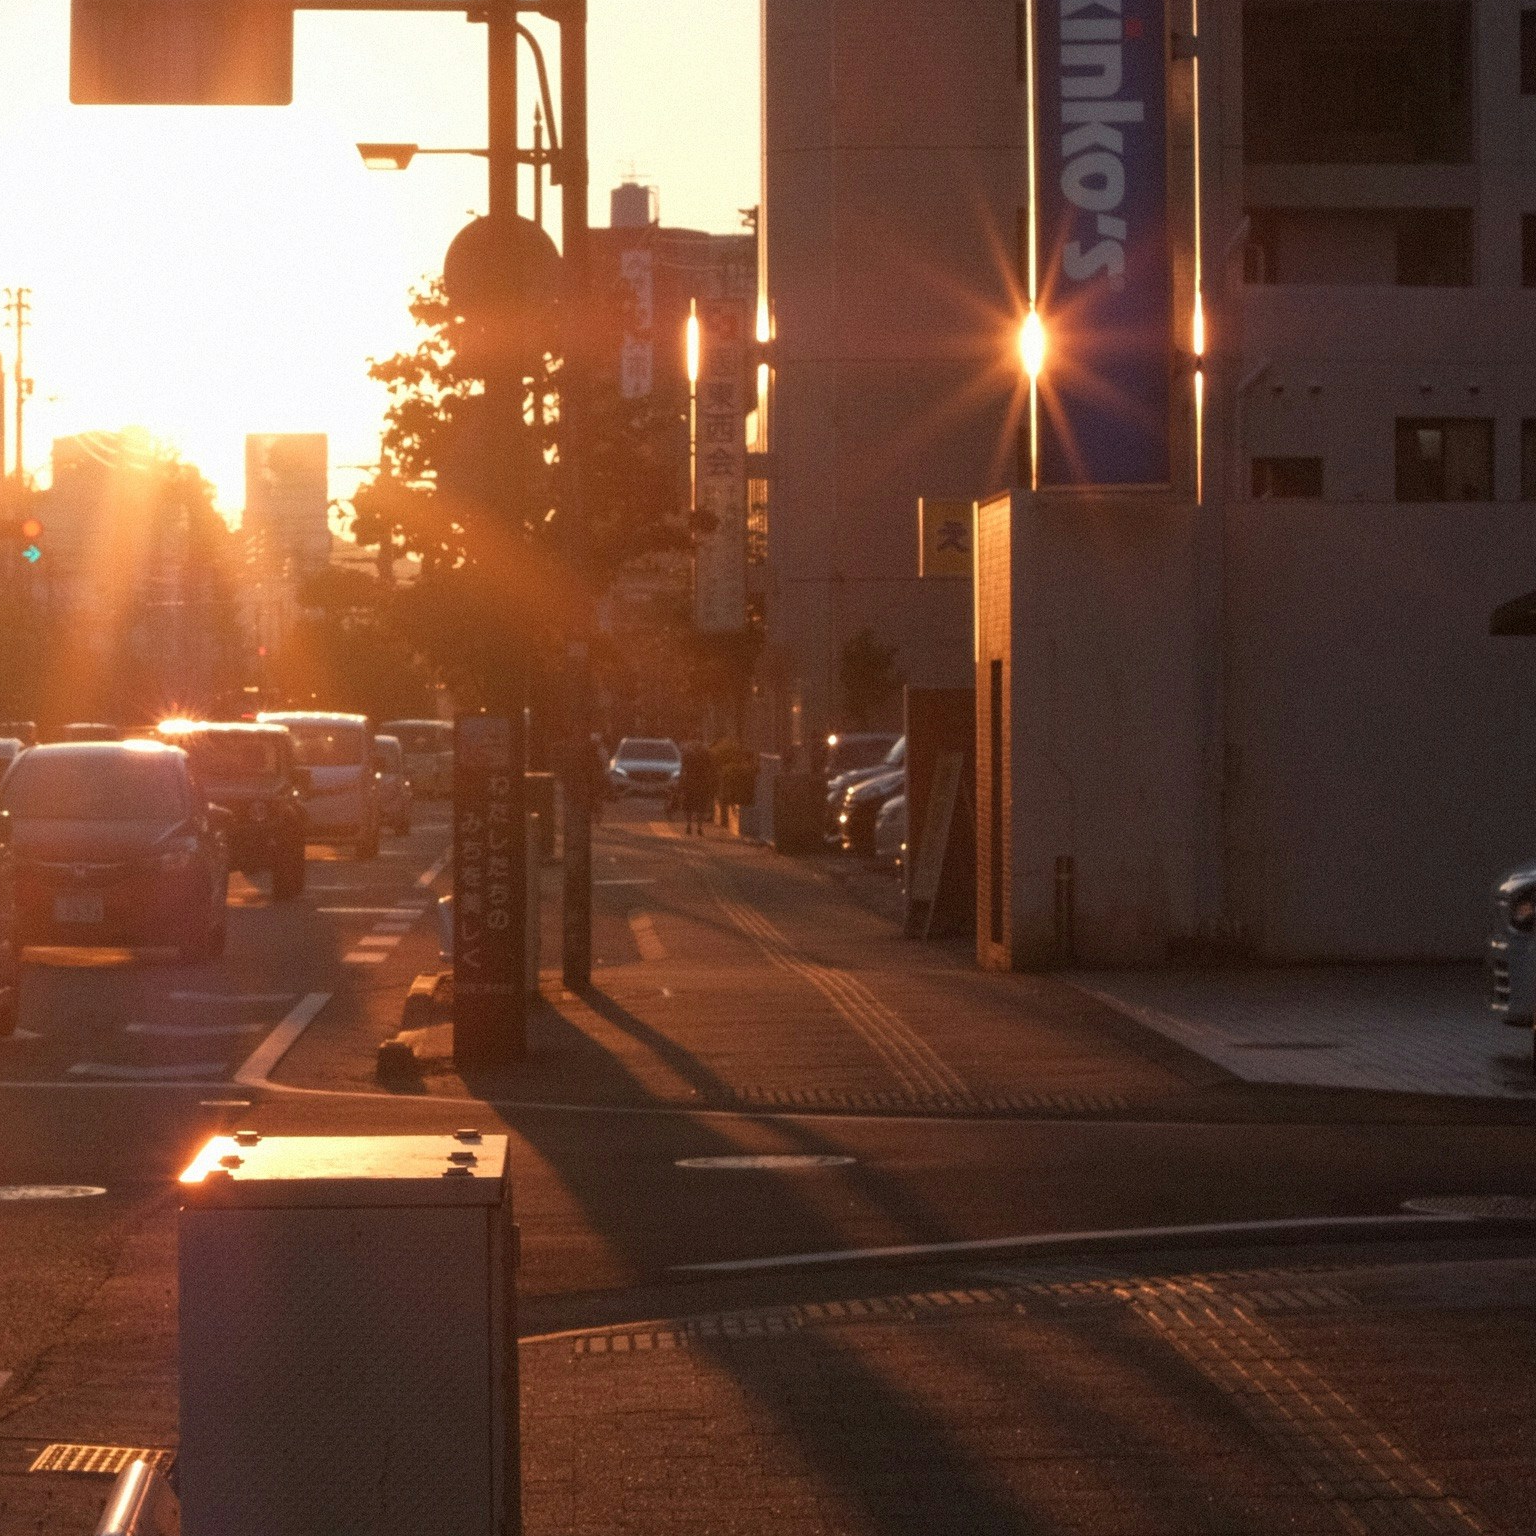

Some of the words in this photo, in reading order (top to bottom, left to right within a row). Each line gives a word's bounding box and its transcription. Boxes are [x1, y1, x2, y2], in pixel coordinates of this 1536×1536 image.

[488, 775, 510, 931] わたしたちの
